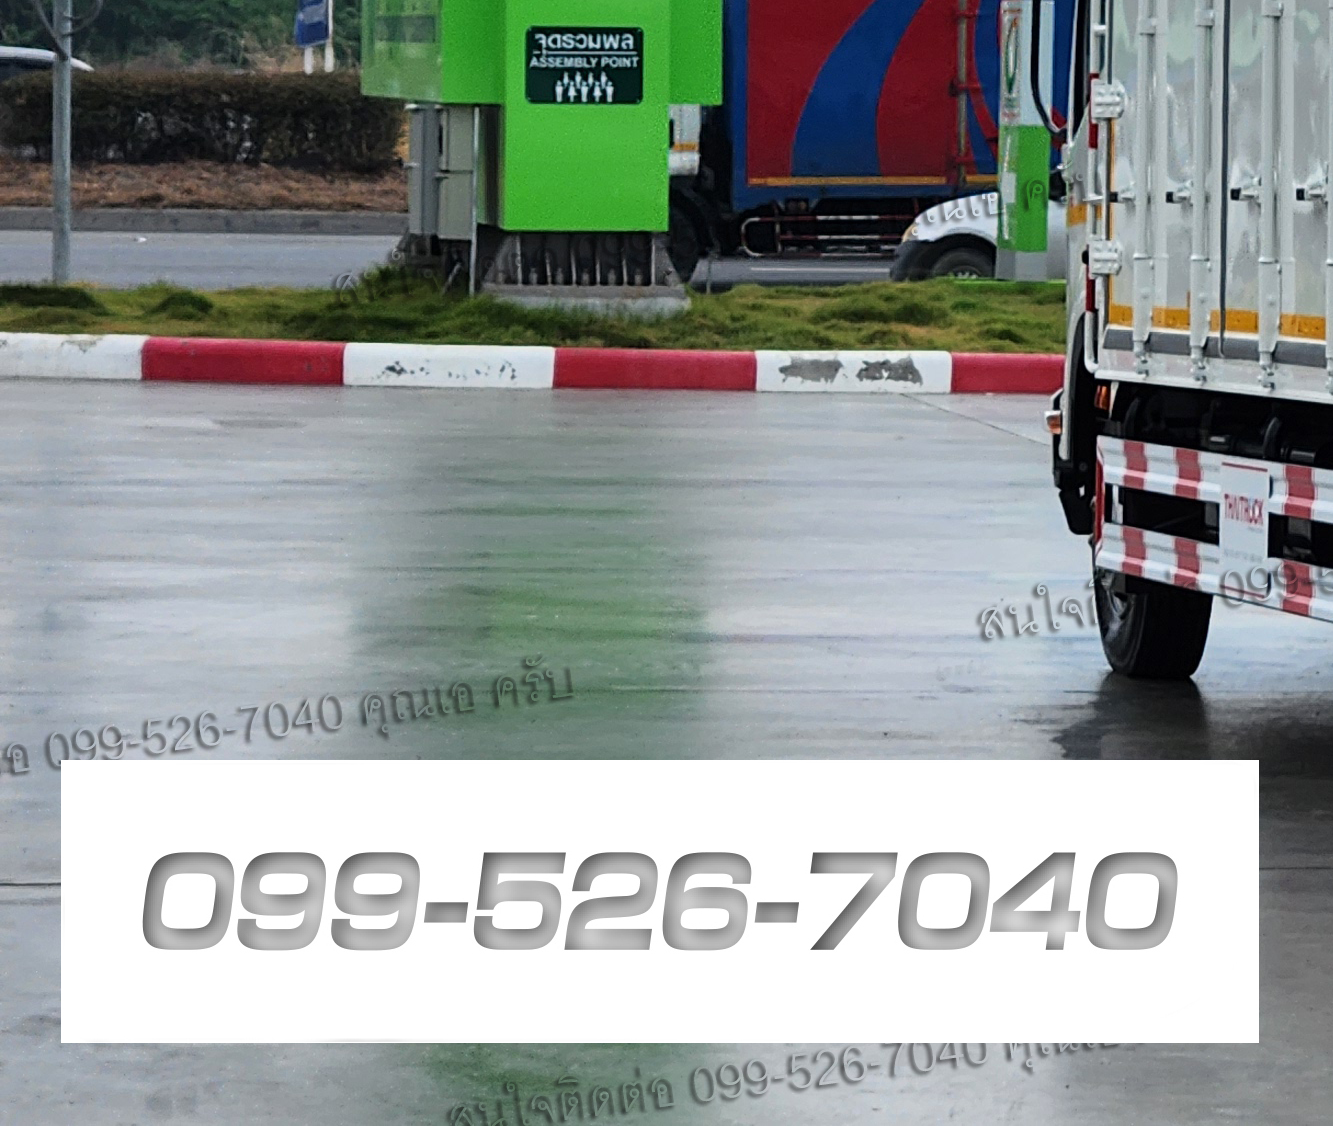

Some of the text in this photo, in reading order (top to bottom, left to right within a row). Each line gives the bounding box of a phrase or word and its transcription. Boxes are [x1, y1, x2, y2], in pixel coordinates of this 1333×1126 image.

[534, 33, 635, 58] จุดรวมพล
[529, 56, 640, 68] ASSEMBLY POINT
